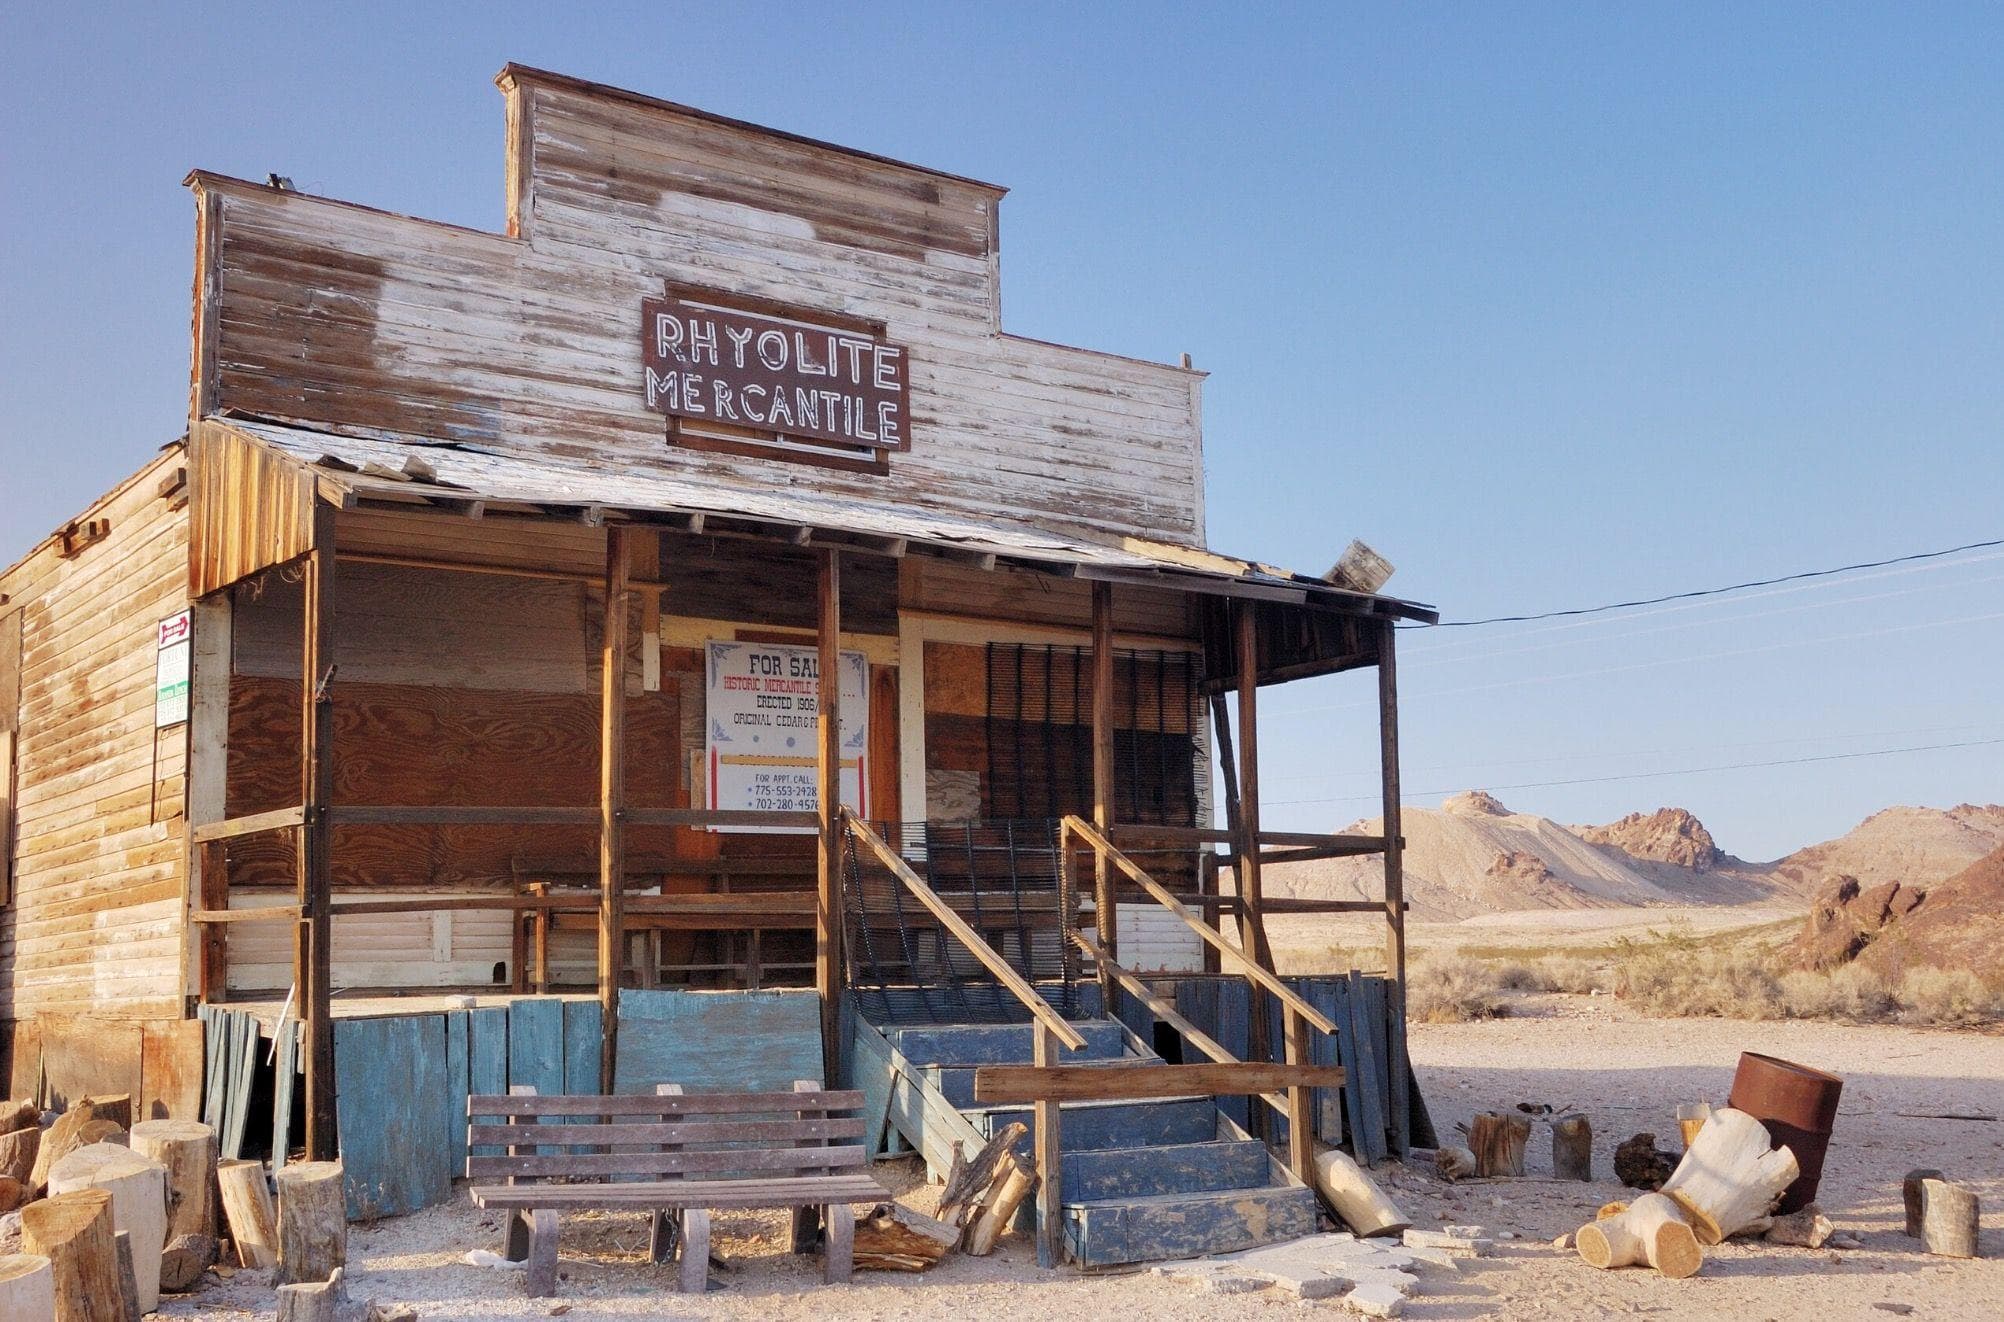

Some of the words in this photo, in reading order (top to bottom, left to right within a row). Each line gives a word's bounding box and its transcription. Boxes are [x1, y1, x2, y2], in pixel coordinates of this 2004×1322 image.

[656, 312, 900, 391] RHYOLITE
[646, 366, 900, 444] MERCANTILE
[749, 654, 782, 676] FOR
[790, 657, 819, 679] SAL
[723, 676, 760, 691] HISTORIC
[764, 679, 811, 695] MERCANTILE
[757, 695, 792, 710] ERECTED
[734, 712, 772, 726] ORIGINAL
[755, 774, 770, 783] FOR
